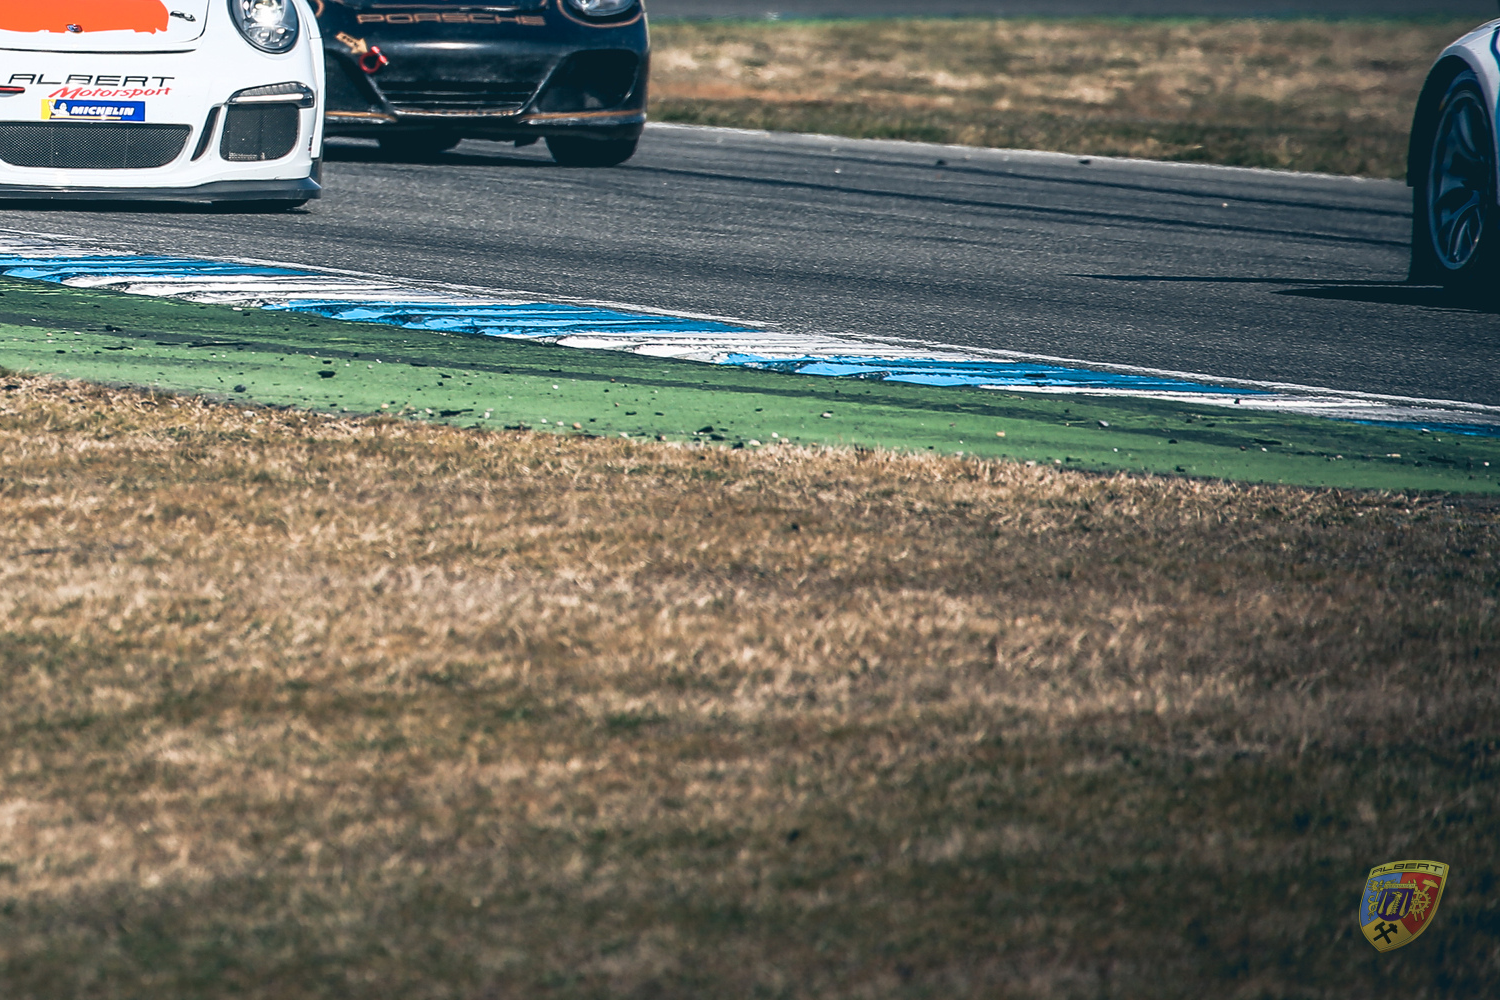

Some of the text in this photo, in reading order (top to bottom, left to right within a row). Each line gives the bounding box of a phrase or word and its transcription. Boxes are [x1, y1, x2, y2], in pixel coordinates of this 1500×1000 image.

[356, 12, 546, 27] PORSCHE
[8, 73, 175, 87] ALBERT
[48, 87, 172, 99] Motorsport
[70, 105, 135, 117] MICHELIN
